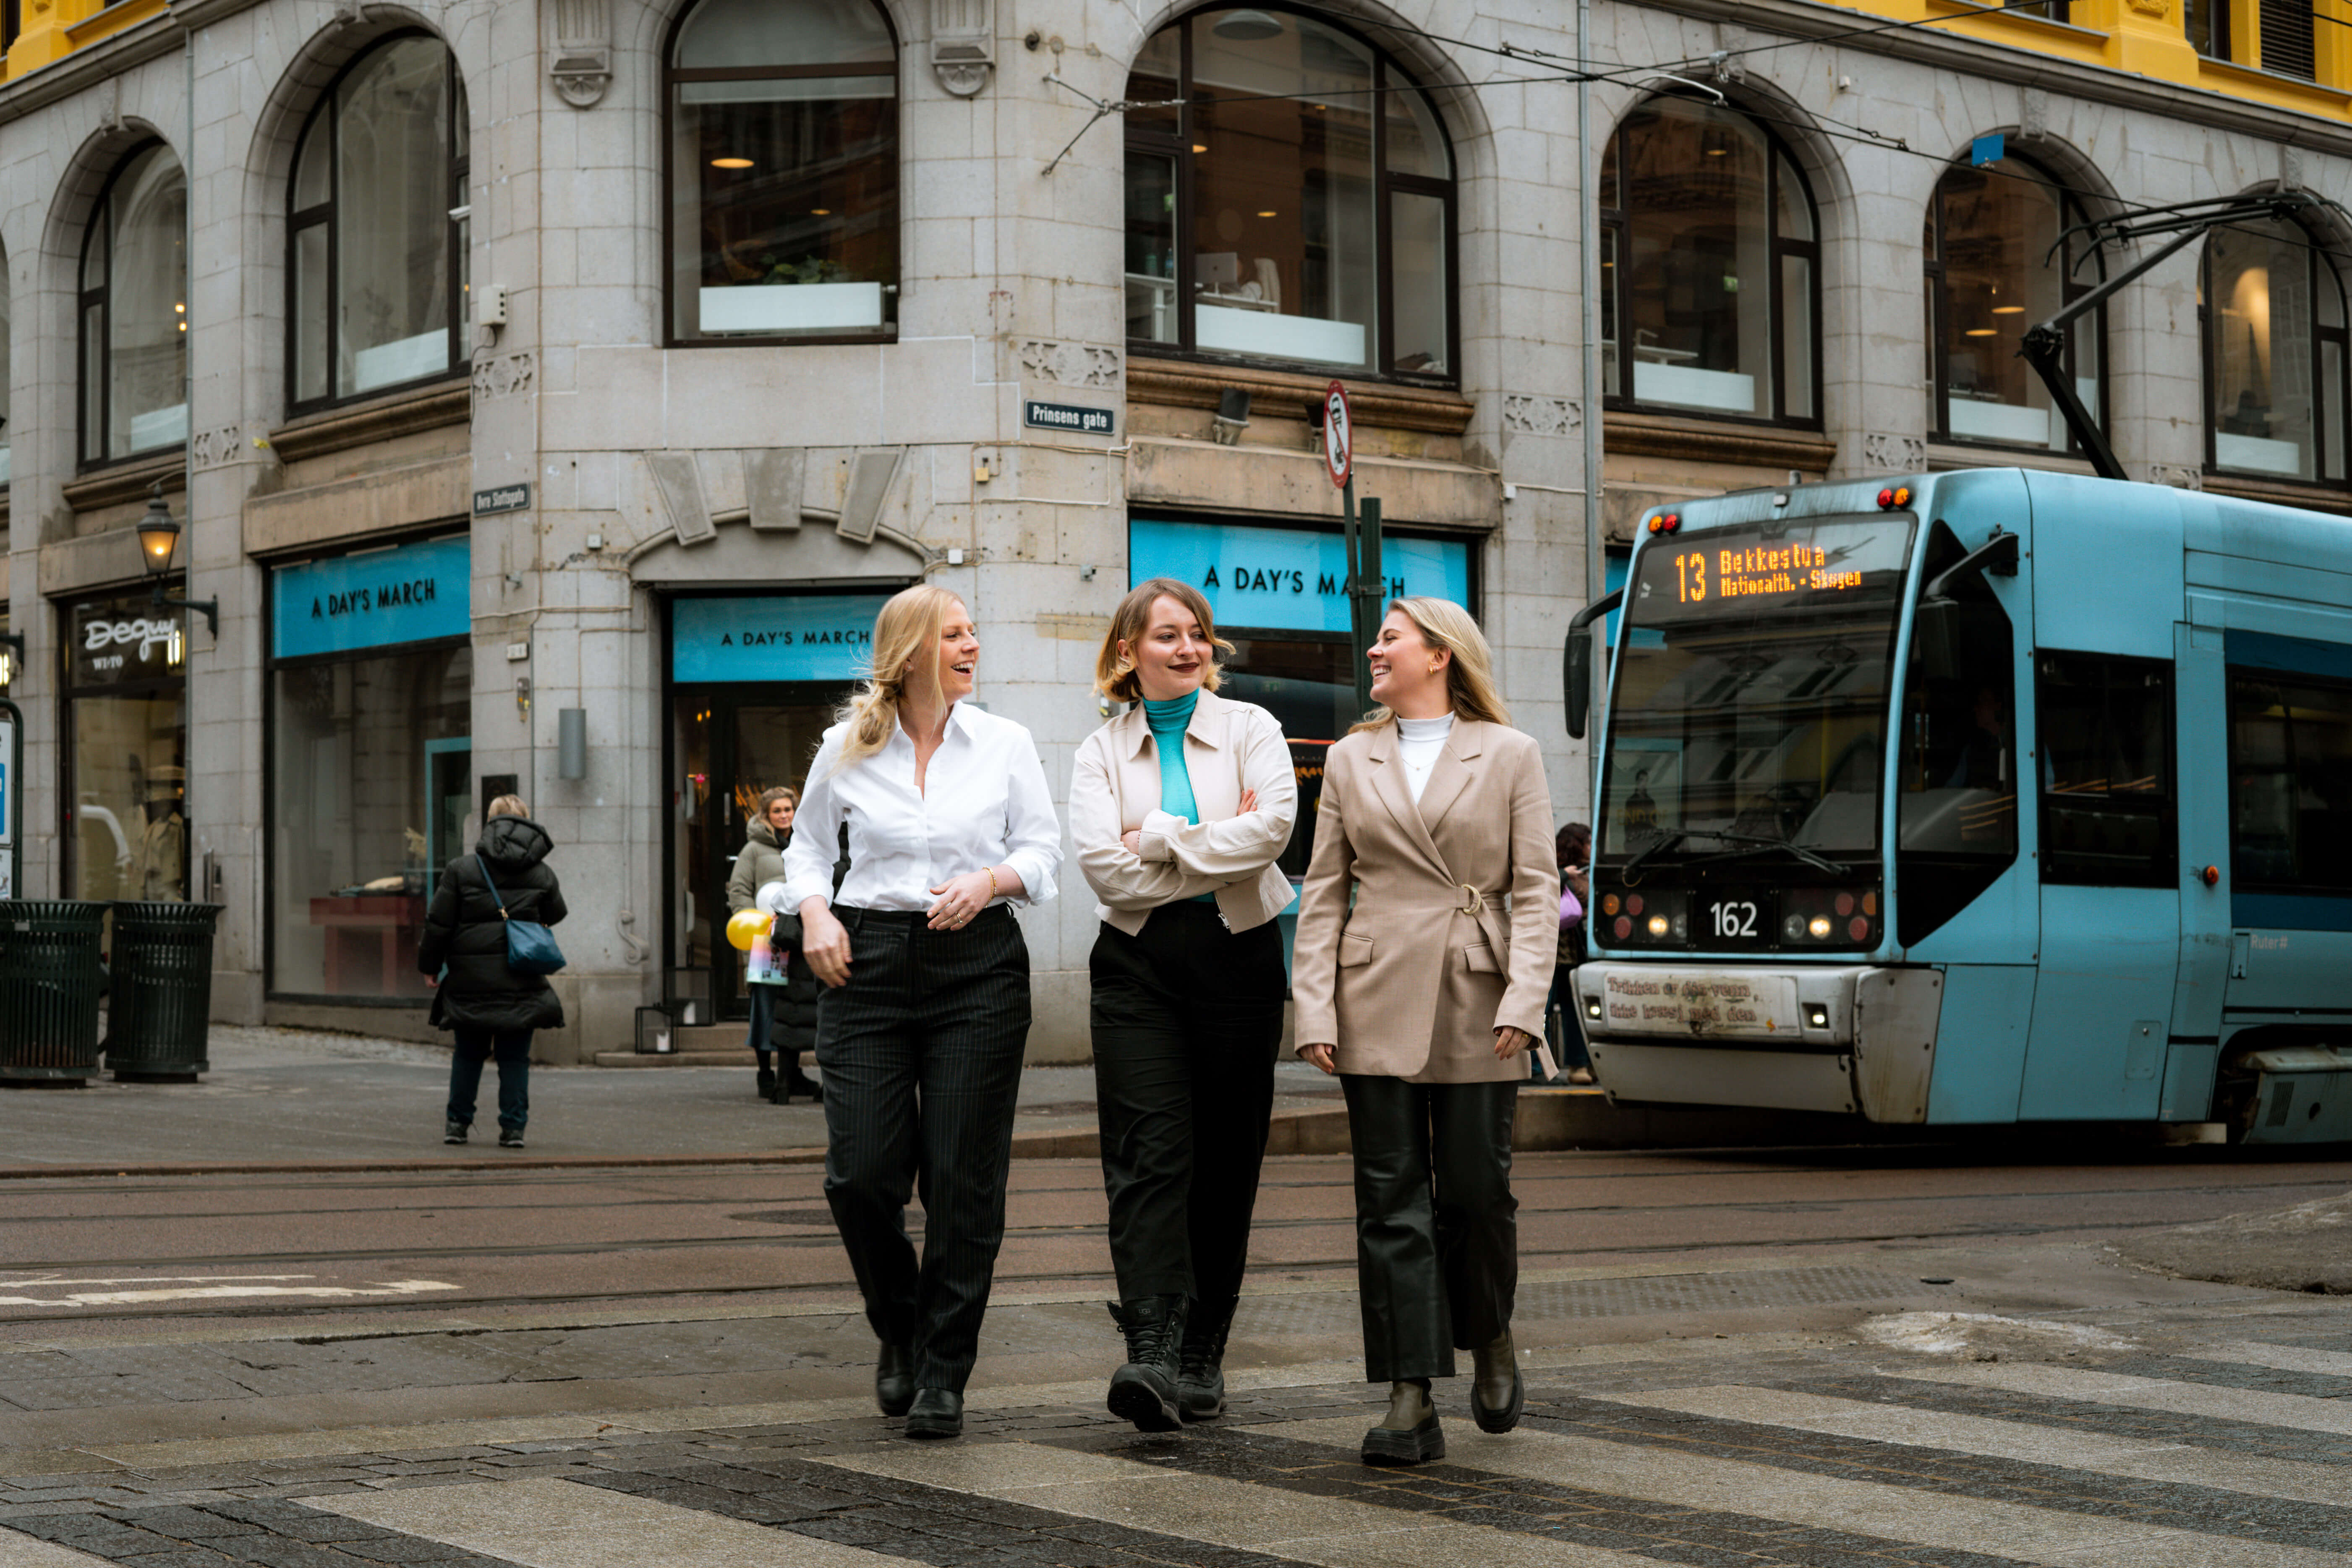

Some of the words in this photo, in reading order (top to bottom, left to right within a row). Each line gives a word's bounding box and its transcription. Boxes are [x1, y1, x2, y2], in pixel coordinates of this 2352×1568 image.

[1033, 405, 1079, 425] Prinsens
[1083, 411, 1107, 430] gate
[1720, 544, 1824, 574] Bekkestua
[1204, 564, 1220, 588] A
[1235, 567, 1304, 594] DAY'S
[1675, 553, 1706, 602] 13
[1721, 572, 1796, 596] Nationalth.
[312, 596, 322, 618] A
[329, 588, 370, 616] DAY'S
[377, 578, 435, 609] MARCH
[721, 632, 733, 646] A
[742, 631, 793, 645] DAY'S
[802, 630, 870, 644] MARCH
[1710, 901, 1758, 937] 162
[1607, 977, 1660, 996] Trikken
[1610, 1003, 1637, 1019] ikke
[1727, 1006, 1758, 1022] den
